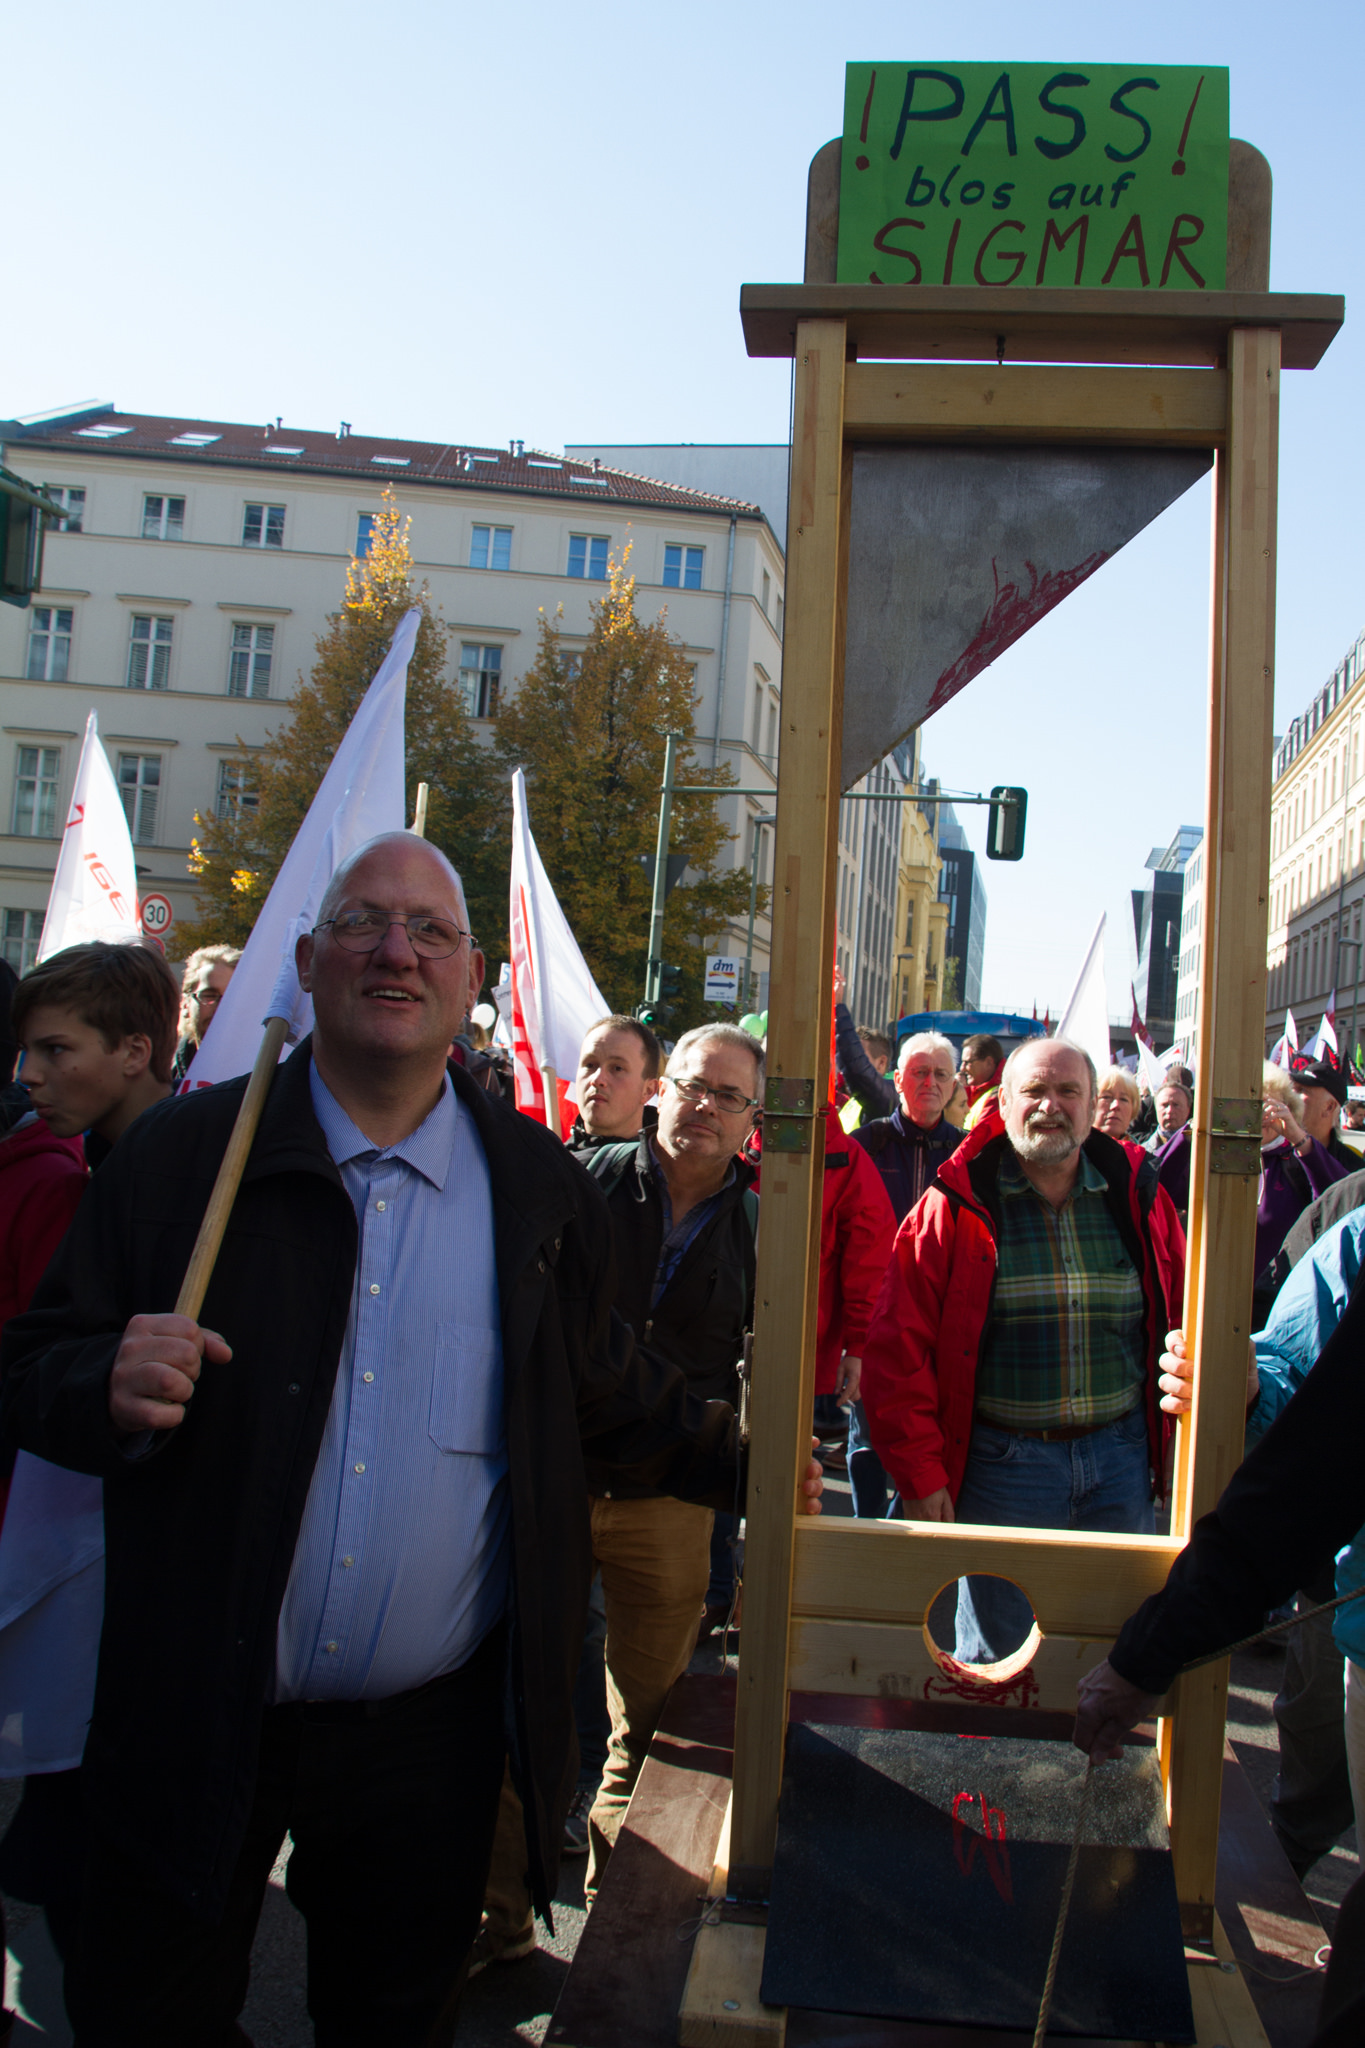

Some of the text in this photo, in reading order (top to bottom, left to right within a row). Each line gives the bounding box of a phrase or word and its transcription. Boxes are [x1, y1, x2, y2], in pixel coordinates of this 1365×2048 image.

[905, 165, 1136, 209] blos auf
[868, 213, 1206, 288] SIGMAR
[145, 904, 166, 924] 30
[712, 959, 734, 971] dm
